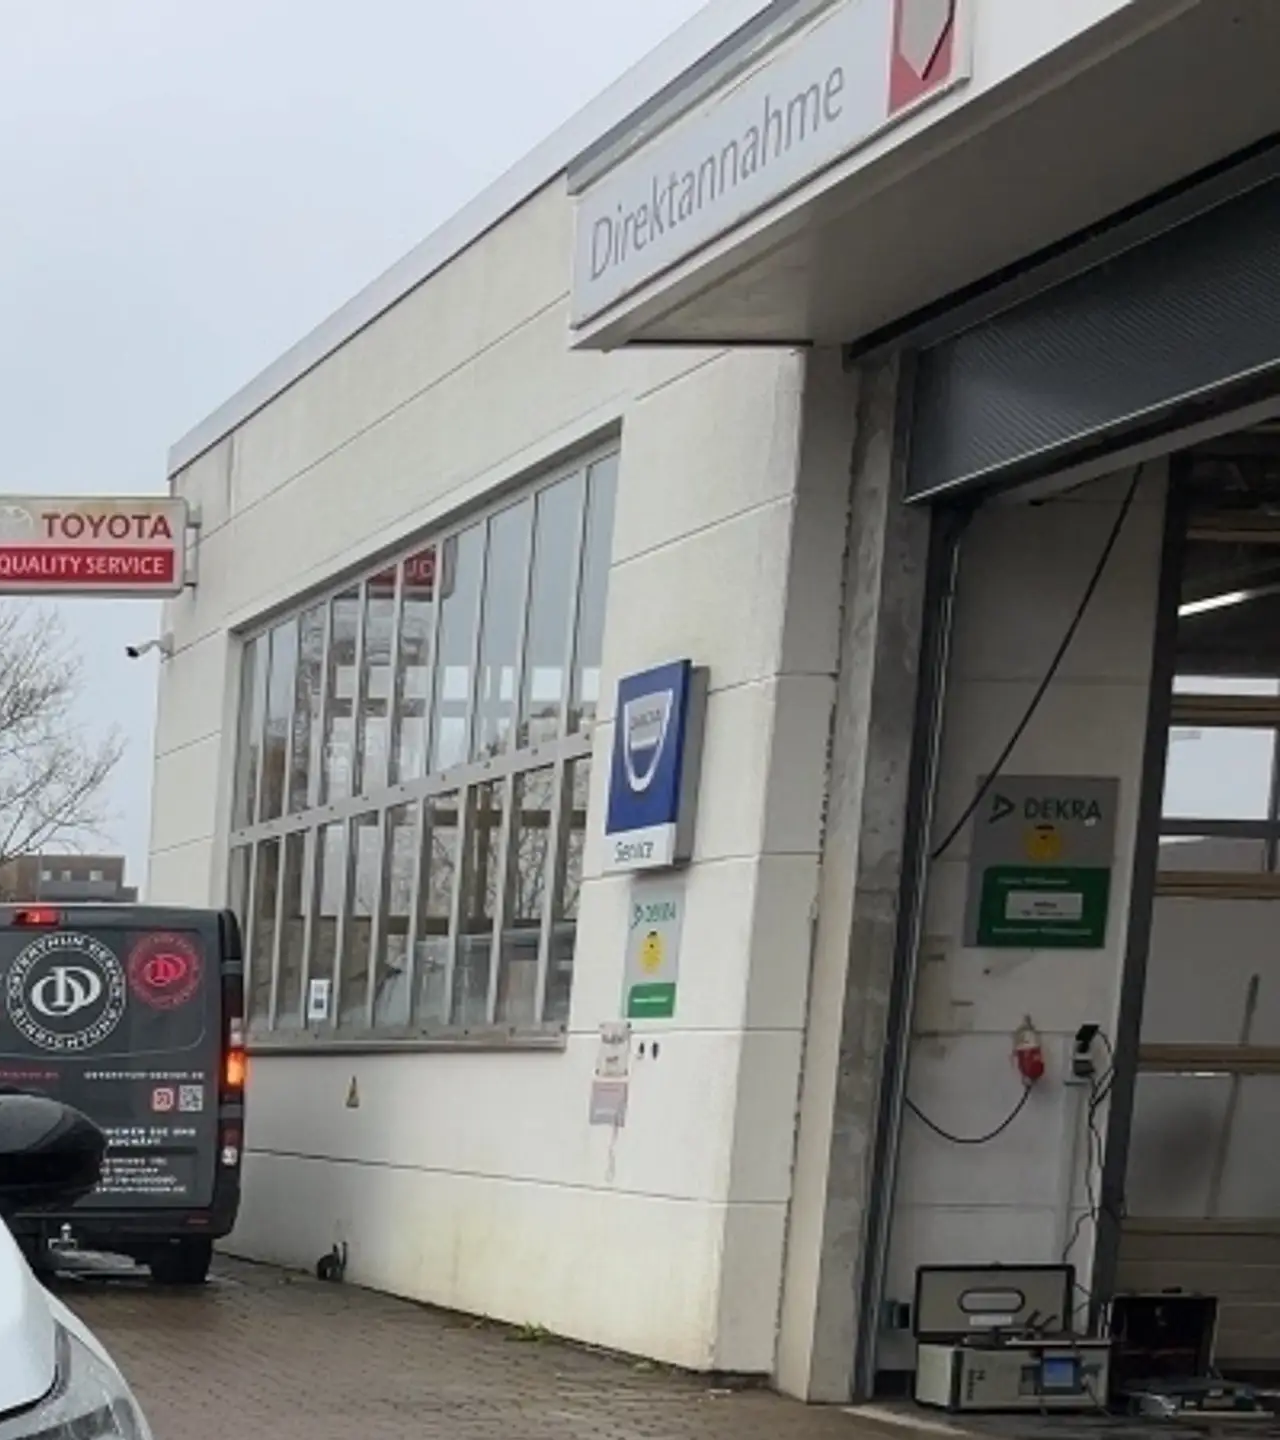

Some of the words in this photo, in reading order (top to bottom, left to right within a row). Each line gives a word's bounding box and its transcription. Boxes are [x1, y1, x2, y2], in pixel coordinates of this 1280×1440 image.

[591, 66, 845, 281] Direktannahme
[42, 513, 171, 538] TOYOTA
[86, 556, 165, 575] SERVICE
[1024, 797, 1101, 820] DEKRA
